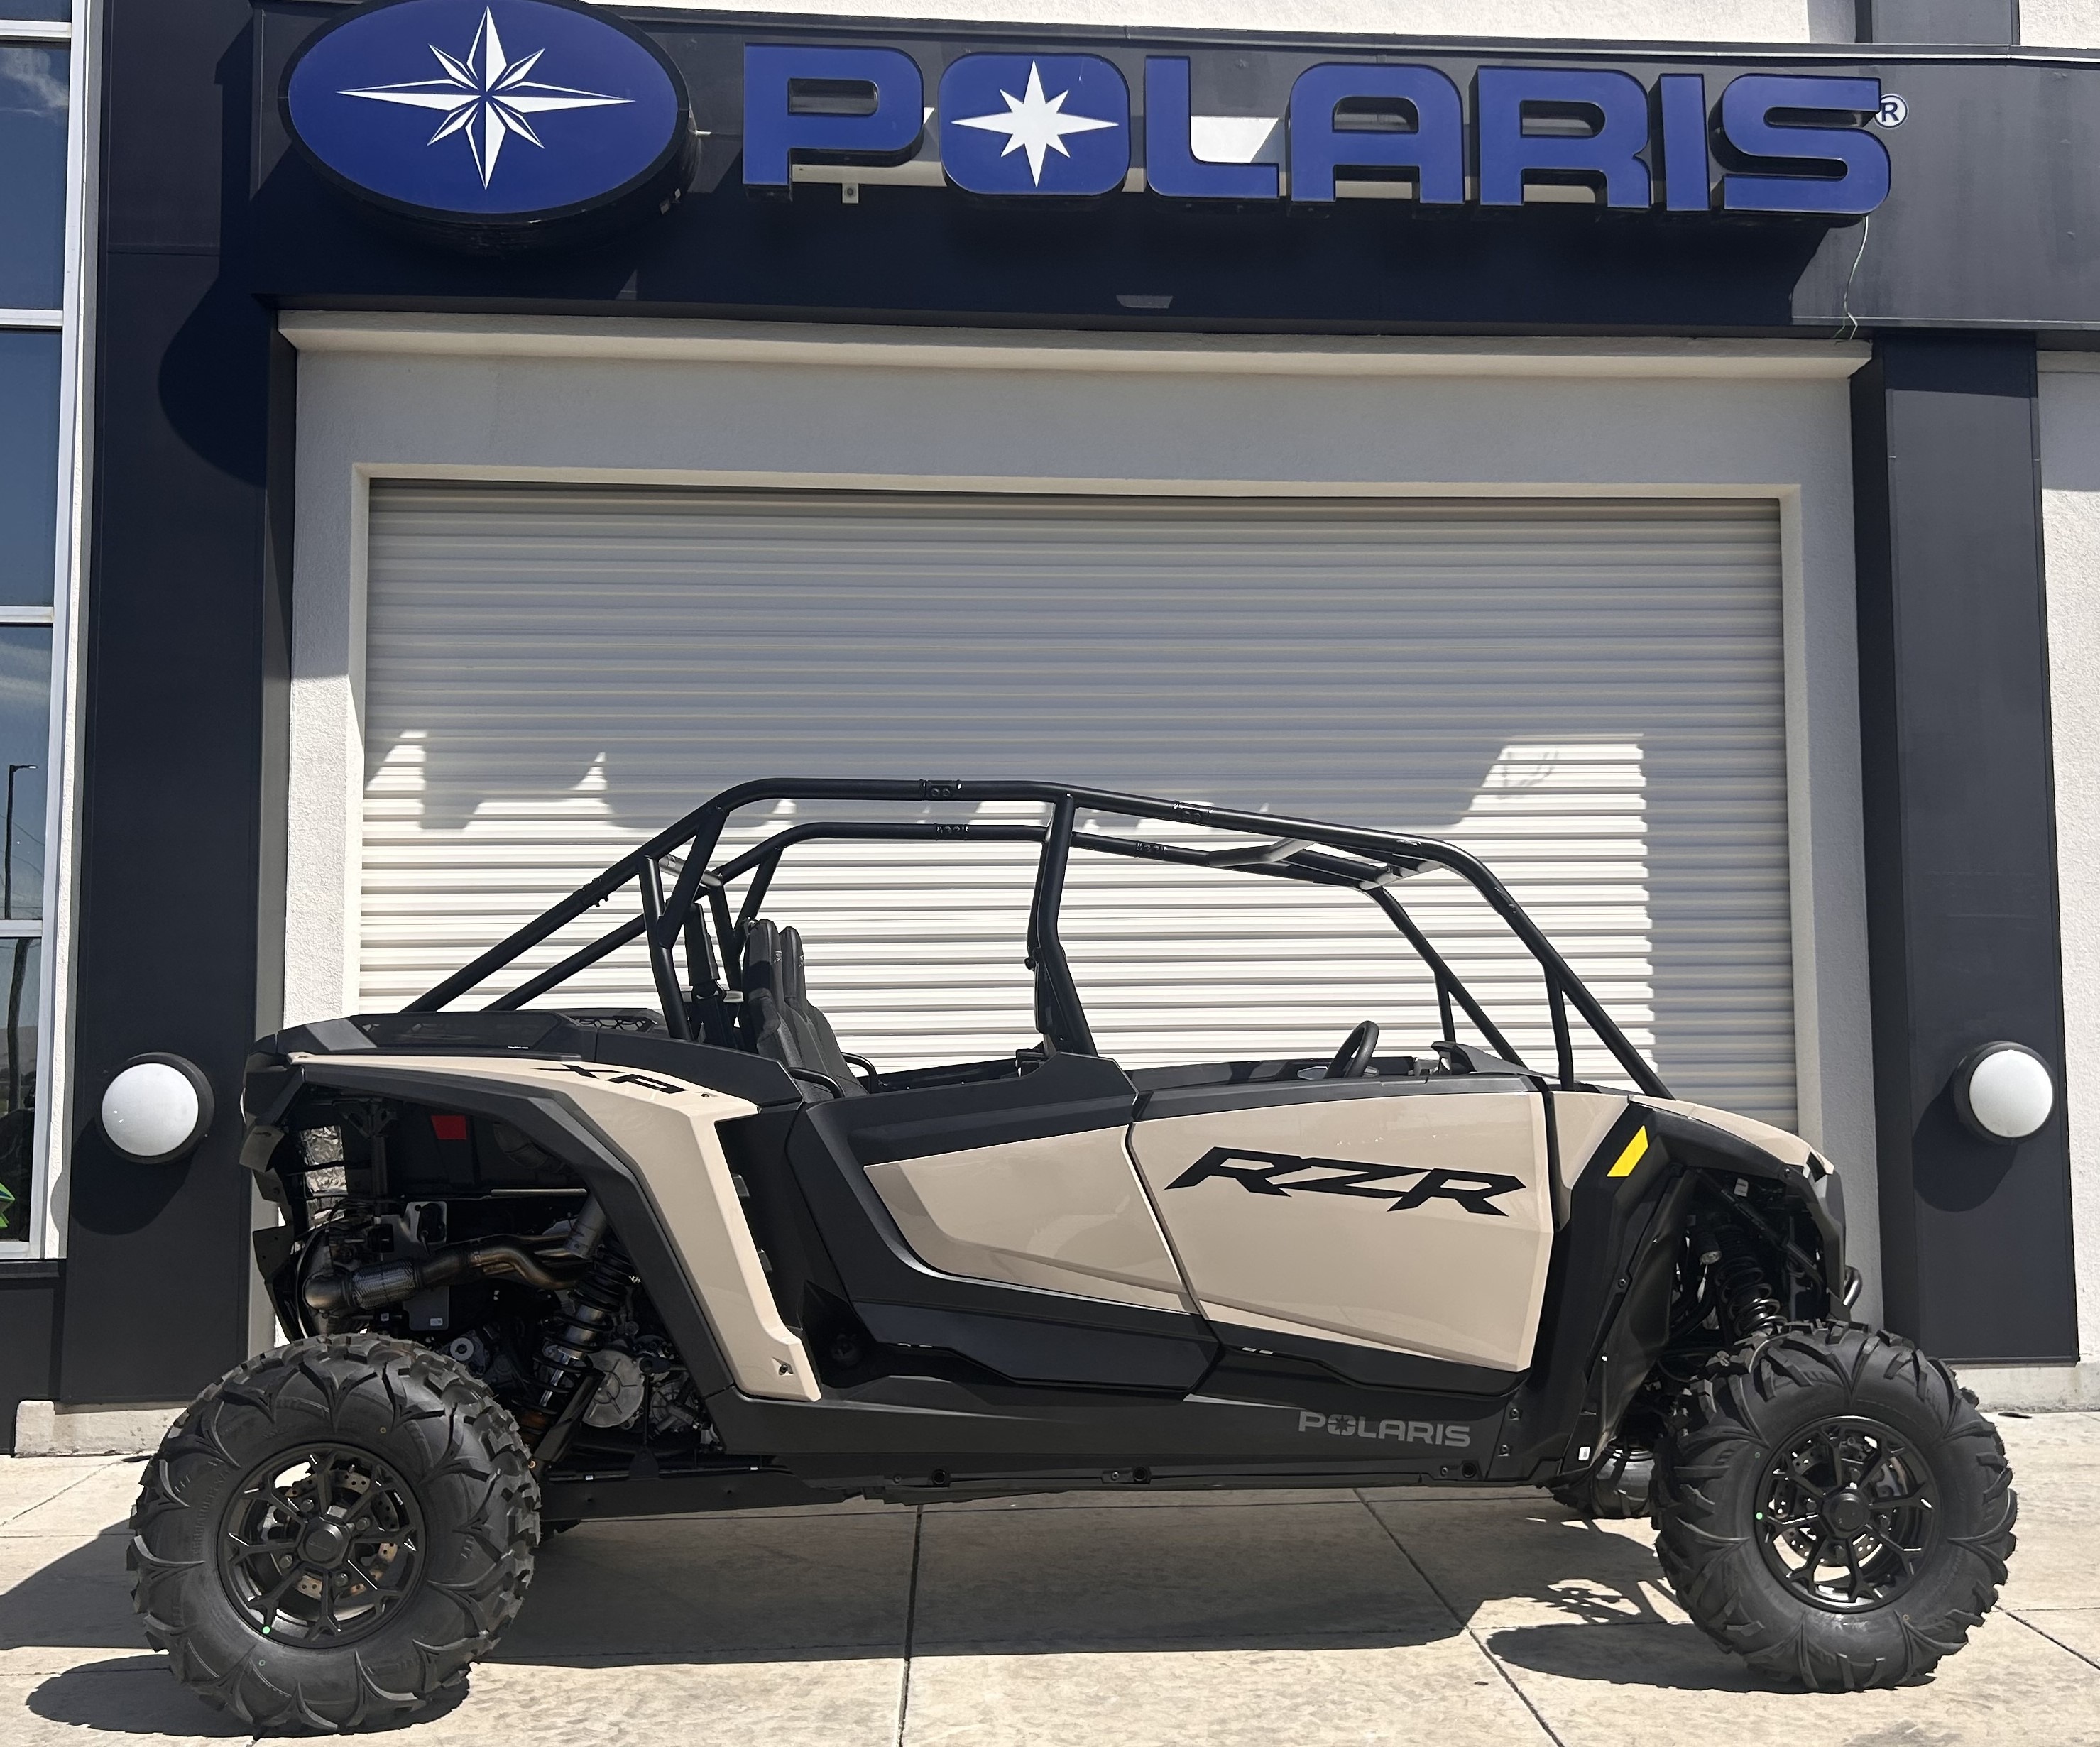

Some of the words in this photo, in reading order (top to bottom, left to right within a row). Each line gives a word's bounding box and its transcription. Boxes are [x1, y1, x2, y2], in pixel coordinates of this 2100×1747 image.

[530, 1063, 688, 1094] XP
[1164, 1146, 1526, 1216] RZR
[1298, 1410, 1471, 1447] POLARIS
